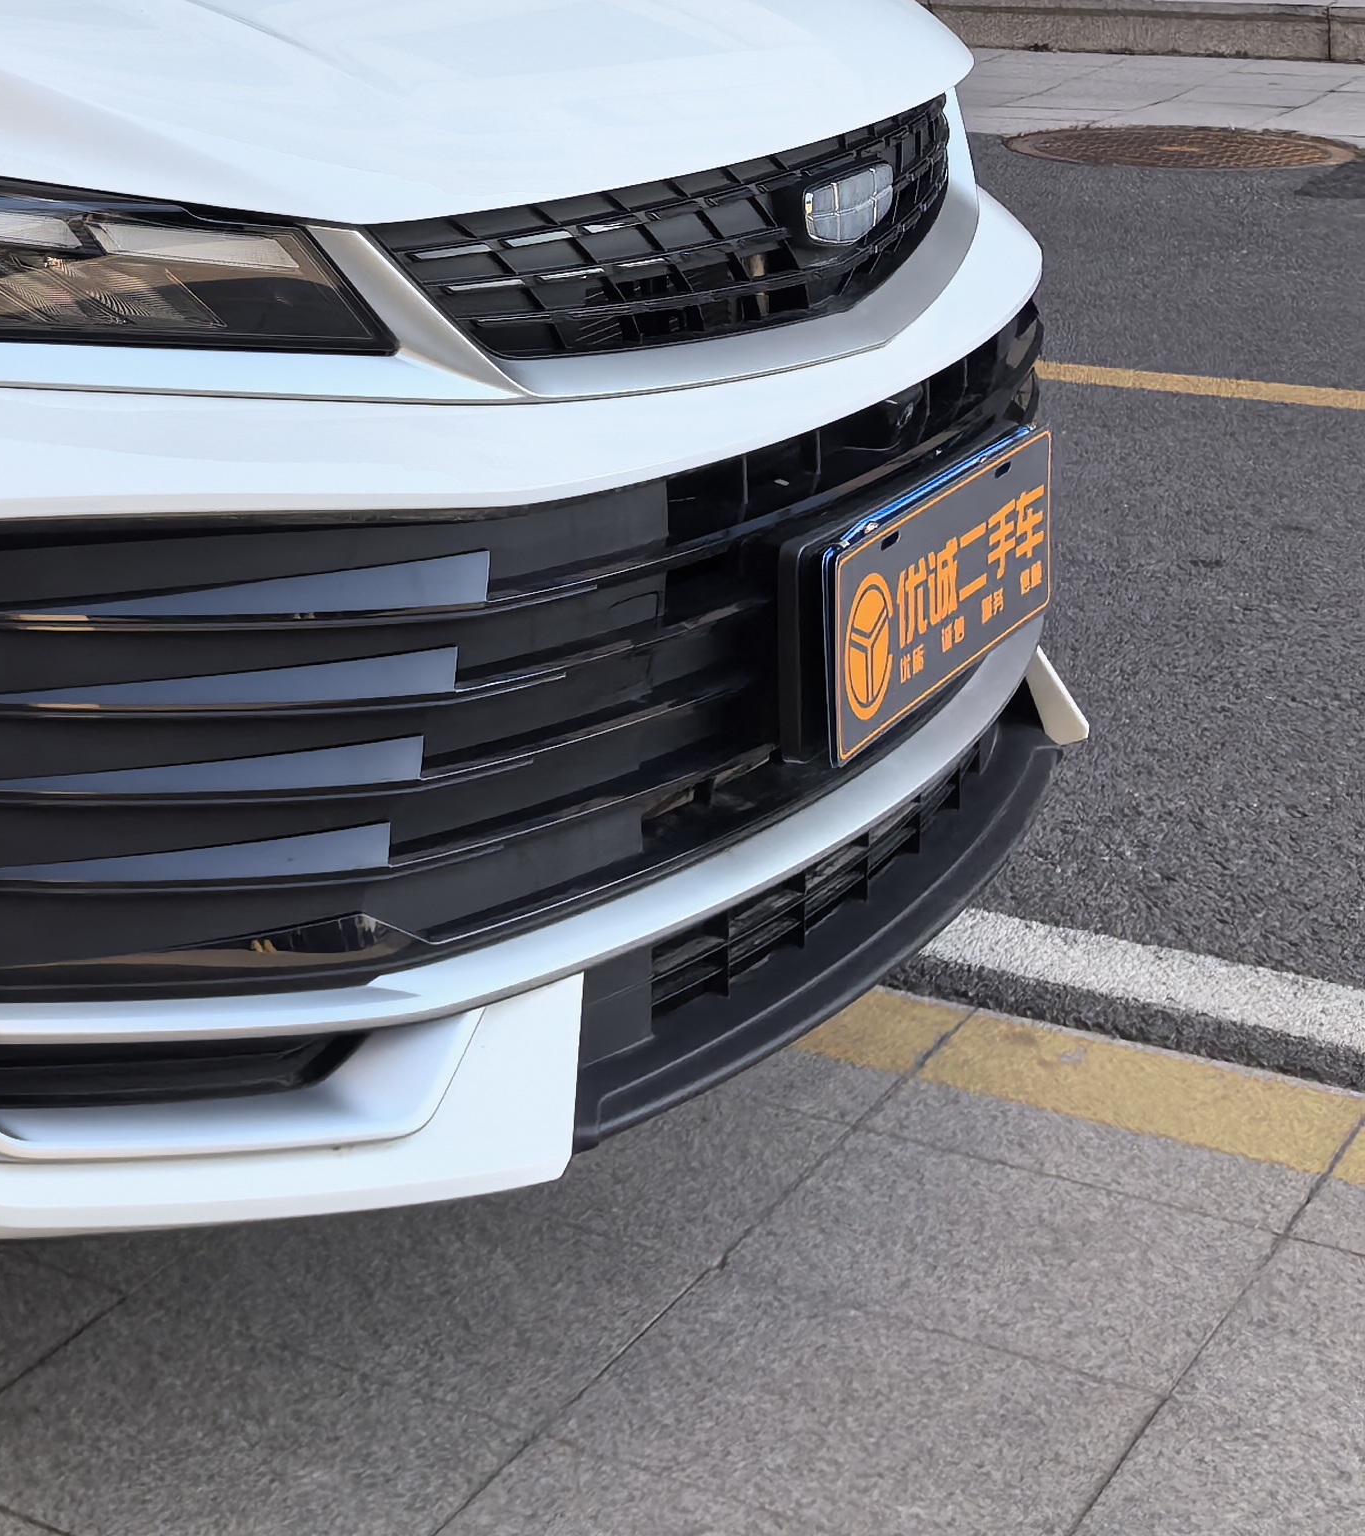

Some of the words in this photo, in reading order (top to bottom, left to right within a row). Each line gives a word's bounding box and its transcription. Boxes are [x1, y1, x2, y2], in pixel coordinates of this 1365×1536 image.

[896, 484, 1045, 649] 优诚二手车
